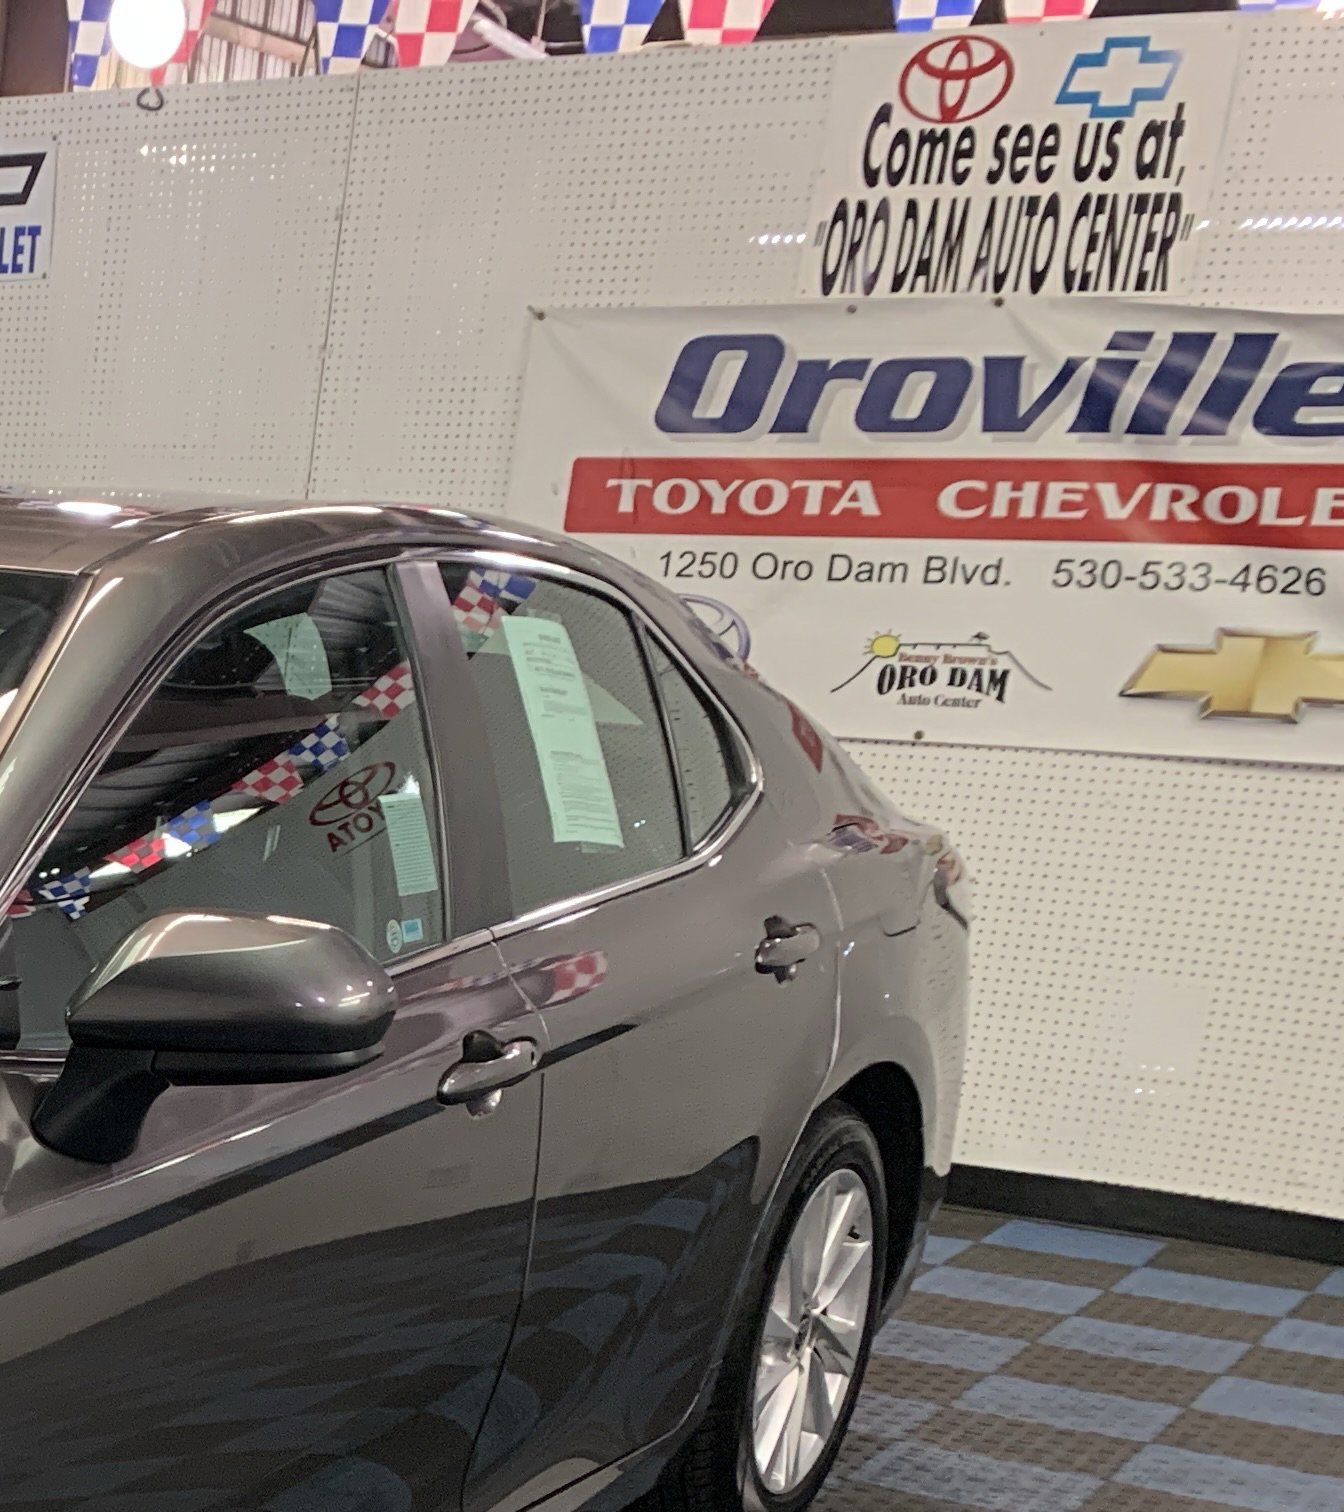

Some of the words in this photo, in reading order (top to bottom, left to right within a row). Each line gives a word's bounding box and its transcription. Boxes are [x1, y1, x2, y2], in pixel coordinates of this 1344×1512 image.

[862, 101, 976, 188] Come
[985, 122, 1061, 186] see
[1073, 119, 1127, 183] us
[1135, 102, 1186, 187] at,
[813, 196, 891, 297] "ORO
[890, 196, 972, 293] DAM
[968, 191, 1062, 295] AUTO
[1063, 191, 1195, 294] CENTER"
[654, 331, 1344, 438] Oroville
[606, 477, 882, 517] TOYOTA
[937, 479, 1344, 528] CHEVROLE
[658, 550, 739, 580] 1250
[751, 552, 813, 582] Oro
[827, 553, 909, 584] Dam
[922, 555, 1012, 587] Blvd.
[1051, 558, 1327, 597] 530-533-4626
[876, 663, 938, 695] ORO
[947, 666, 1011, 704] DAM
[896, 692, 931, 706] Auto
[933, 694, 983, 709] Center
